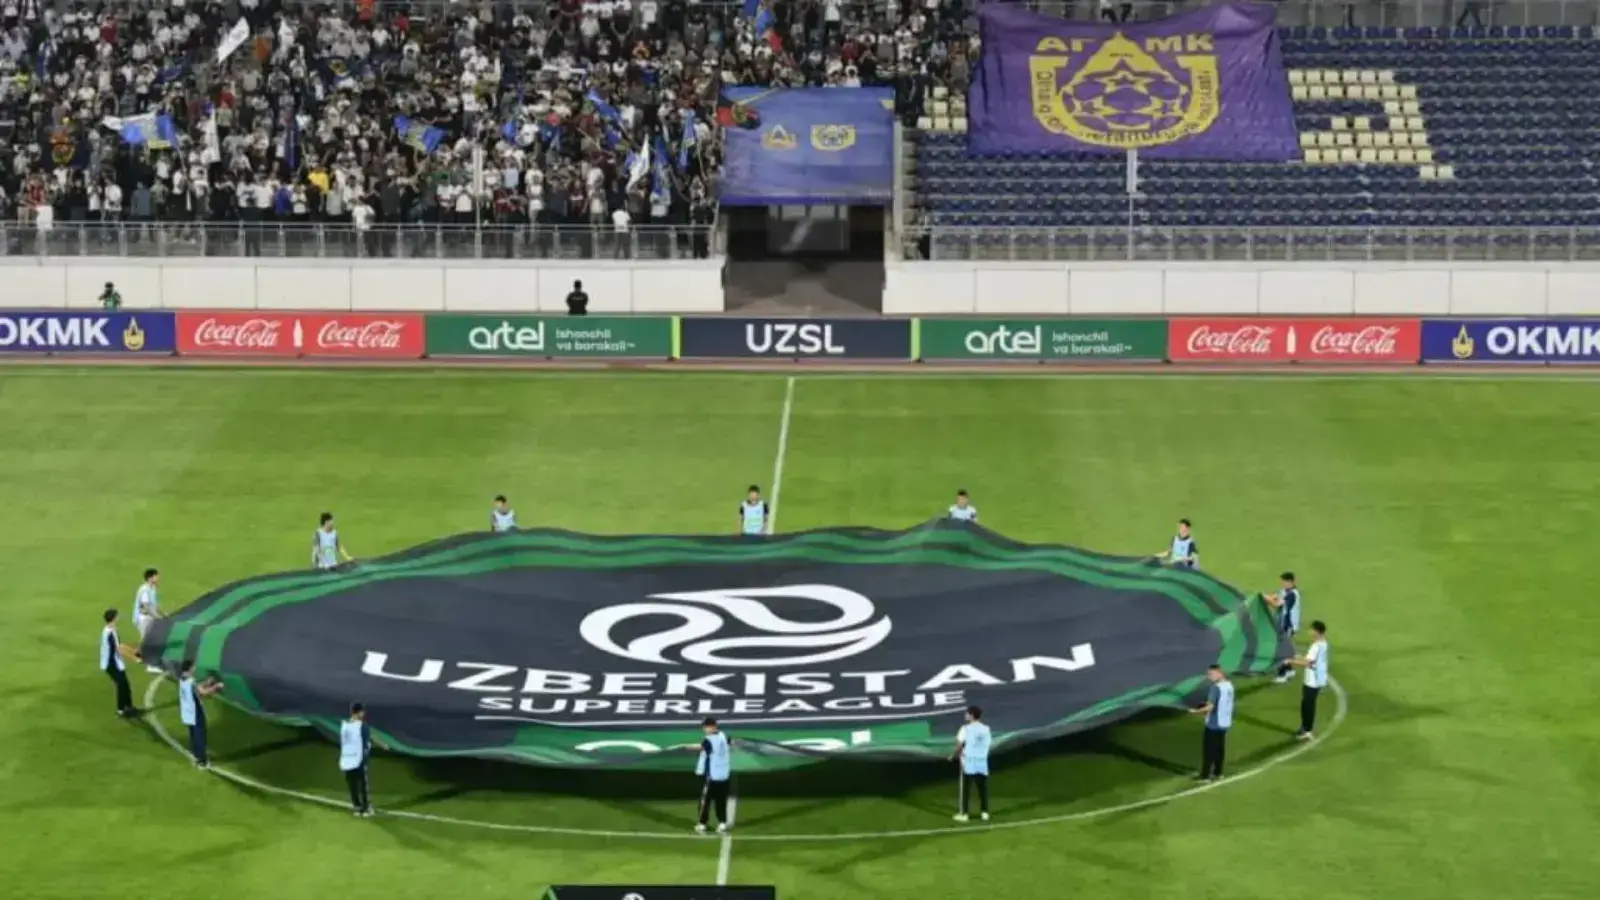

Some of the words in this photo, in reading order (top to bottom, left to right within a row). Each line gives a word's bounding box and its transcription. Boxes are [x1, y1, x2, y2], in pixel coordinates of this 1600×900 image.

[0, 317, 110, 346] OKMK
[194, 318, 282, 348] Coca-Cola
[317, 320, 405, 348] Coca-Cola
[468, 320, 545, 350] artel
[745, 323, 846, 353] UZSL
[964, 324, 1041, 354] artel
[1187, 325, 1275, 353] Coca-Cola
[1311, 325, 1400, 353] Coca-Cola
[361, 643, 1096, 696] UZBEKISTAN
[478, 690, 968, 714] SUPERLEAGUE
